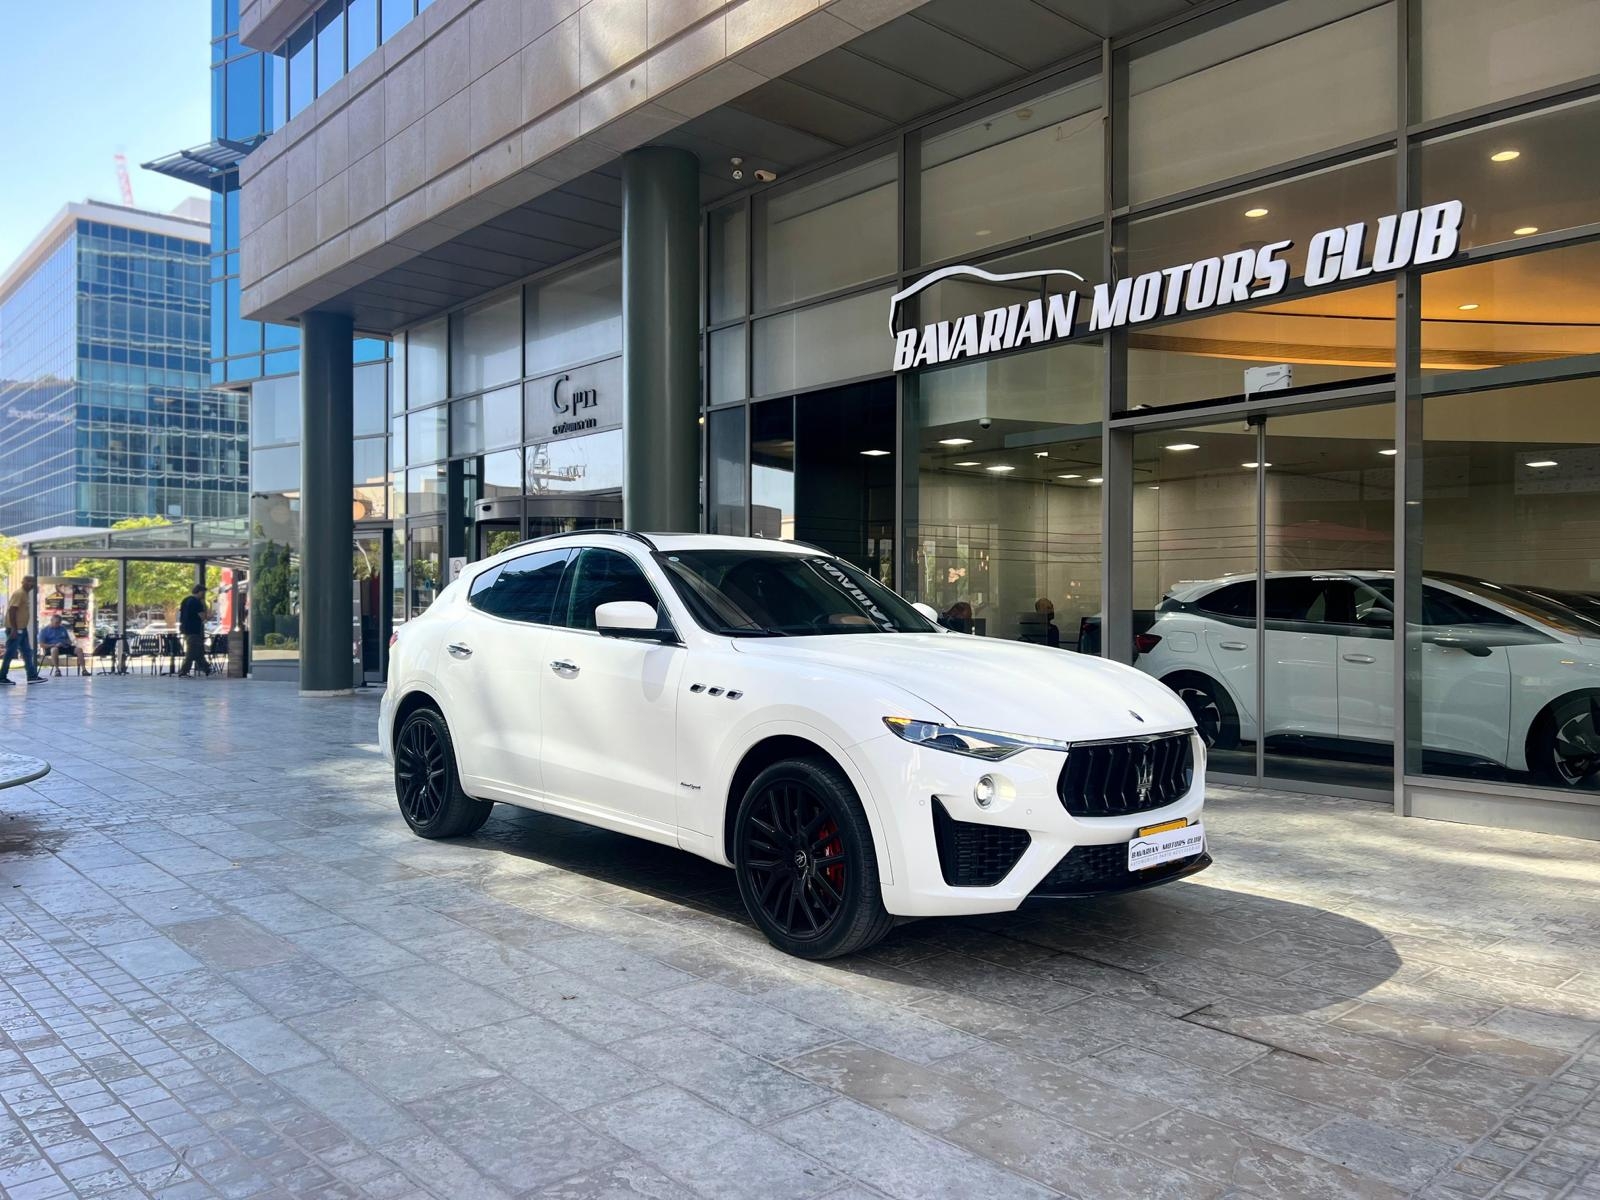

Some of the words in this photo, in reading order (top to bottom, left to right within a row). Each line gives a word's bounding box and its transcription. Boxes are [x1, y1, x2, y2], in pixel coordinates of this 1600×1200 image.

[893, 290, 1079, 372] BAVARIAN
[1088, 239, 1293, 333] MOTORS
[1303, 199, 1465, 288] CLUB
